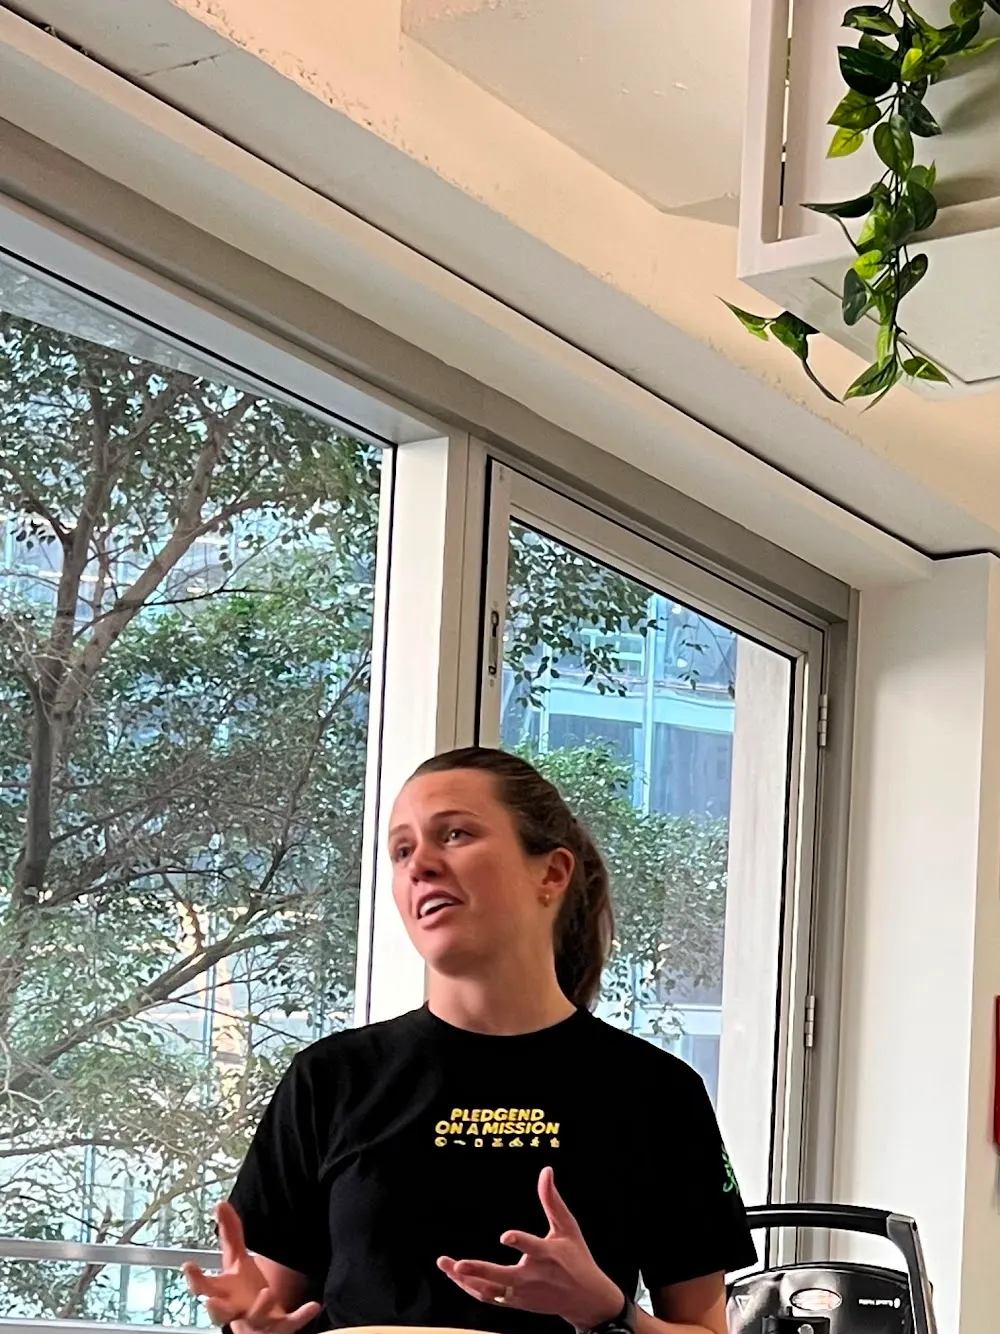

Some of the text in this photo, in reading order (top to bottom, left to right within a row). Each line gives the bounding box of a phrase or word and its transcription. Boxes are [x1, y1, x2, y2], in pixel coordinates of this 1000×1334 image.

[450, 1108, 545, 1122] PLEDGEND
[435, 1121, 560, 1135] ON A MISSION
